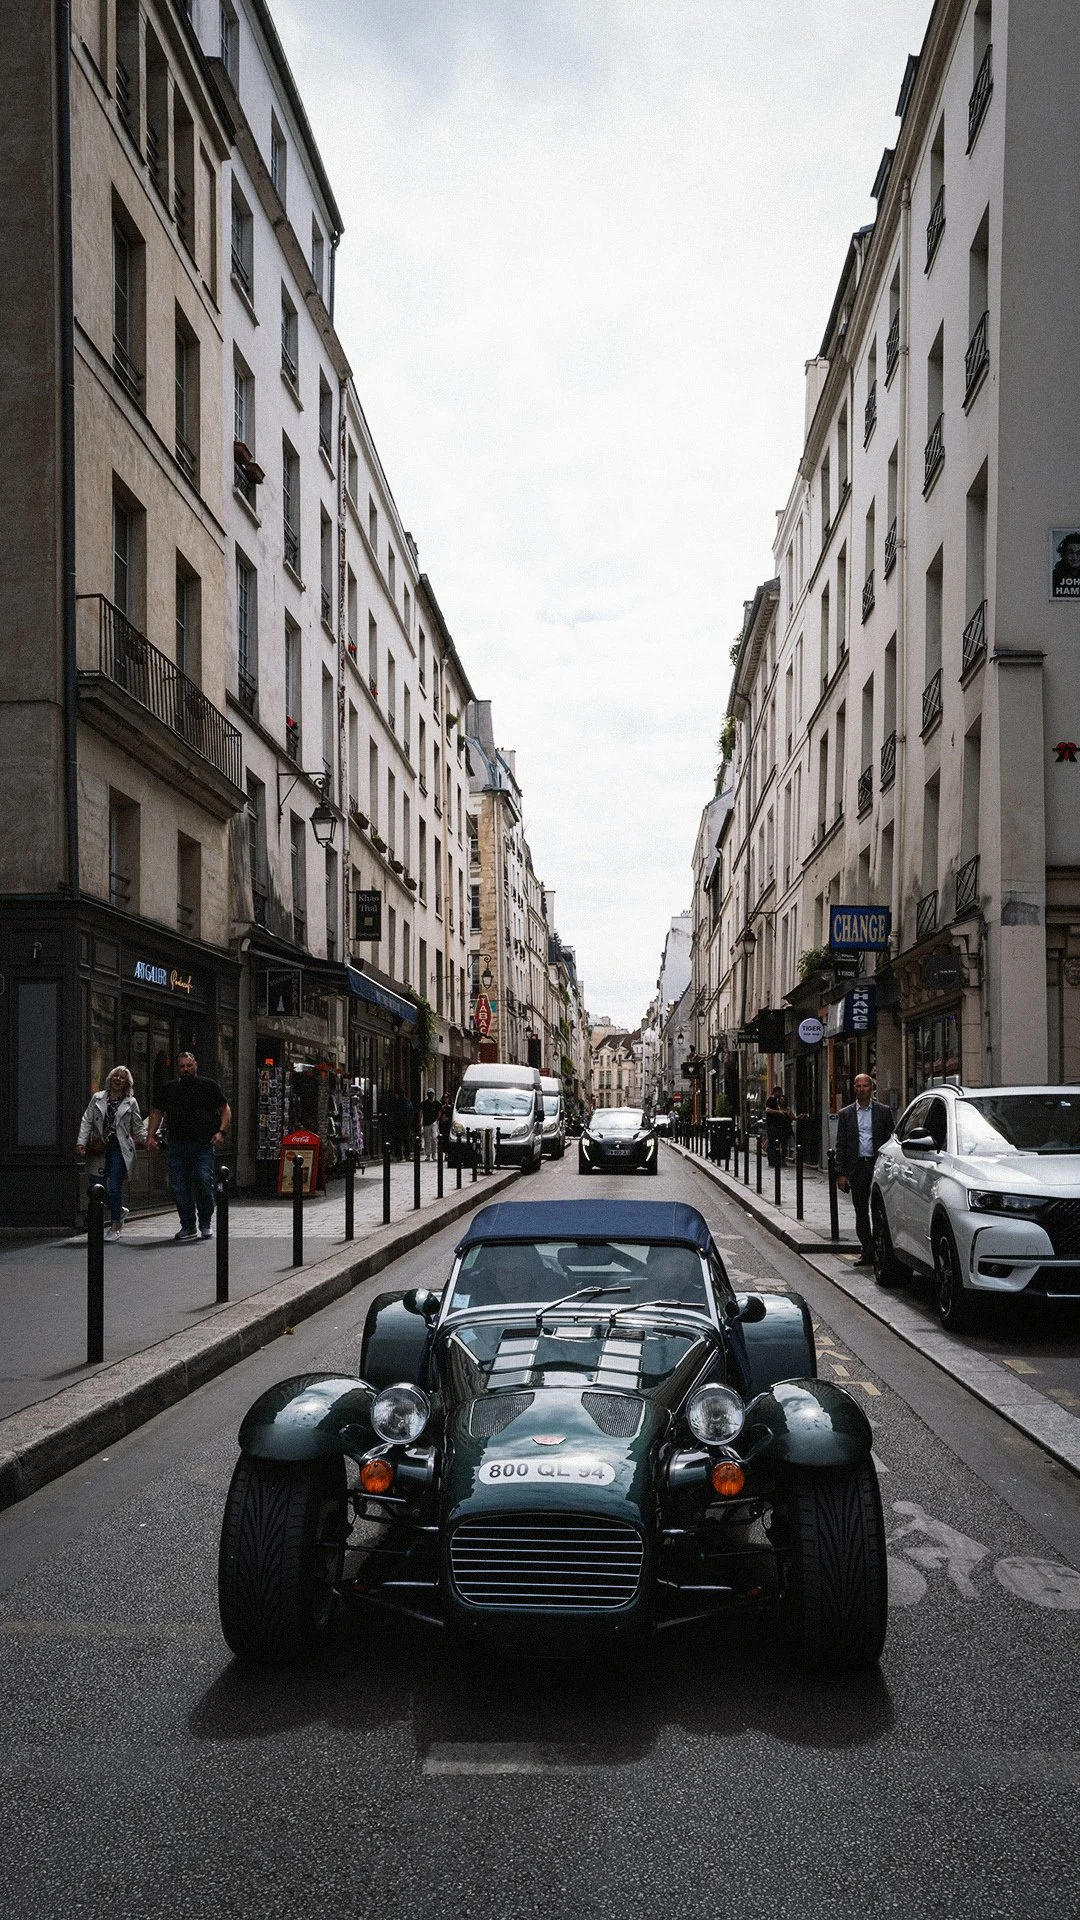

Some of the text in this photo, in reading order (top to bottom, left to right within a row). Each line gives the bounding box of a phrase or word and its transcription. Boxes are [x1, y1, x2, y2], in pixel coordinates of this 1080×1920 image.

[358, 894, 380, 902] Khao
[834, 914, 886, 942] CHANGE
[134, 961, 146, 979] ART
[478, 998, 488, 1034] TABAC
[852, 986, 869, 1030] CHANGE
[489, 1463, 529, 1478] 800
[537, 1462, 570, 1477] QL
